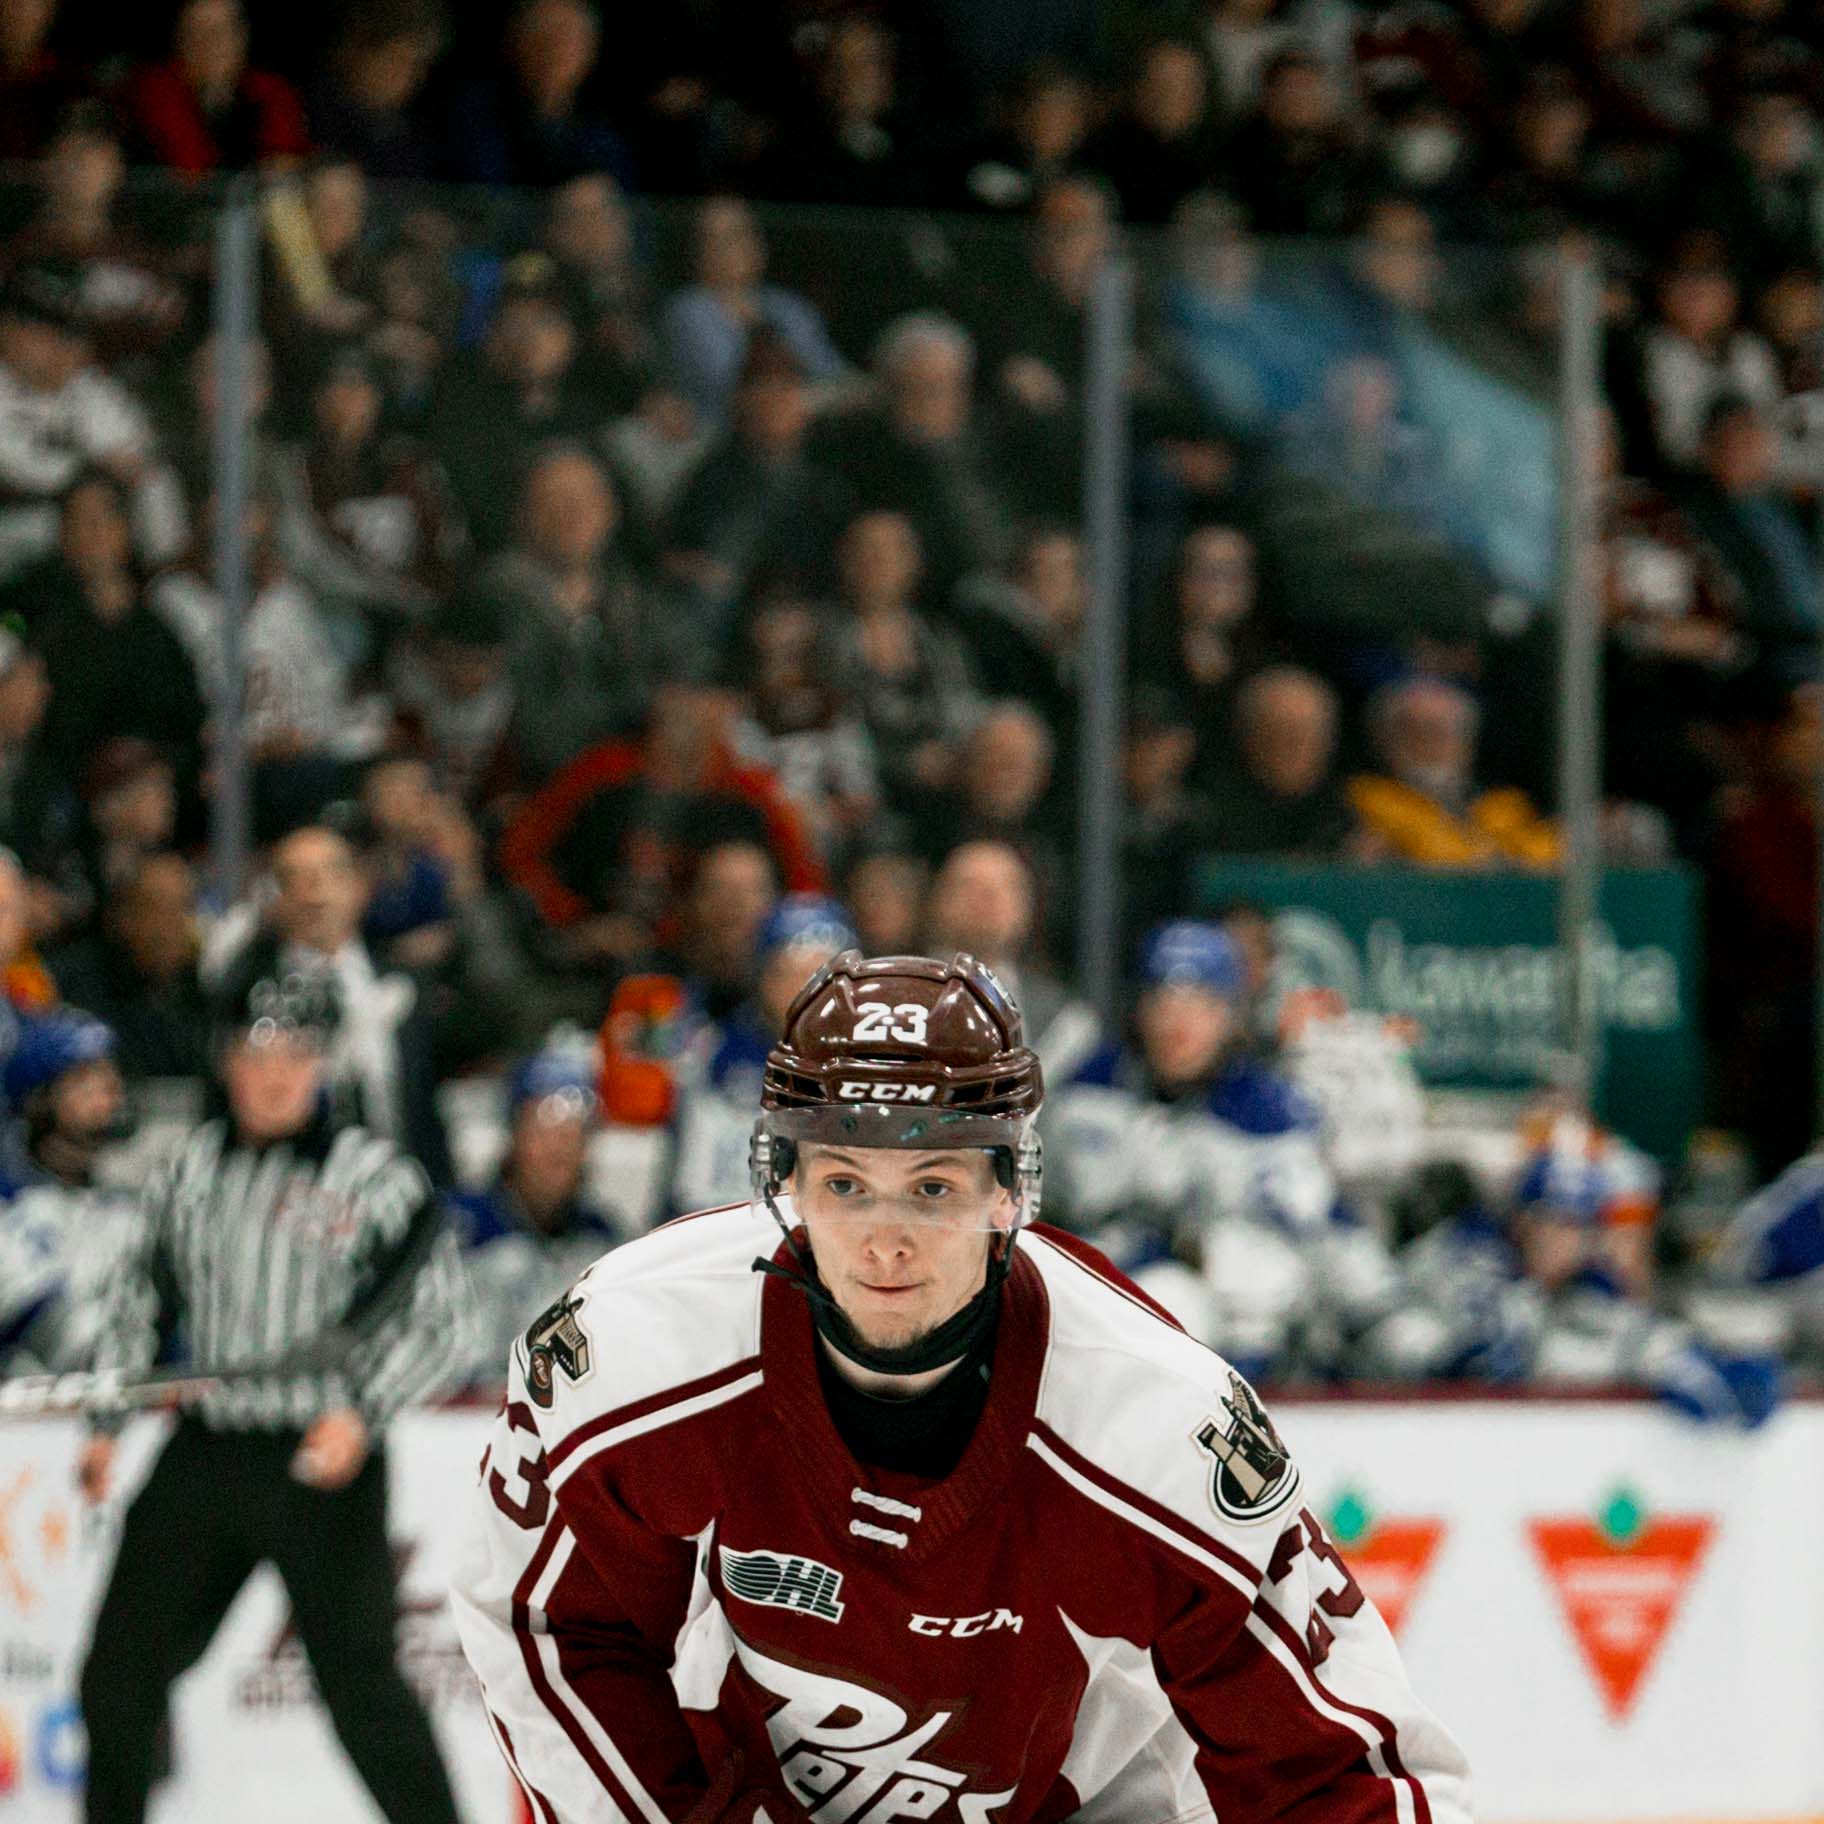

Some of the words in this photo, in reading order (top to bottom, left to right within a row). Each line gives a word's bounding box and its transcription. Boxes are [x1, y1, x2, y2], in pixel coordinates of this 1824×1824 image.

[853, 1002, 929, 1042] 23
[838, 1081, 937, 1101] CCM
[480, 1394, 552, 1531] 3
[719, 1545, 845, 1624] OHL
[908, 1608, 1023, 1638] CCM
